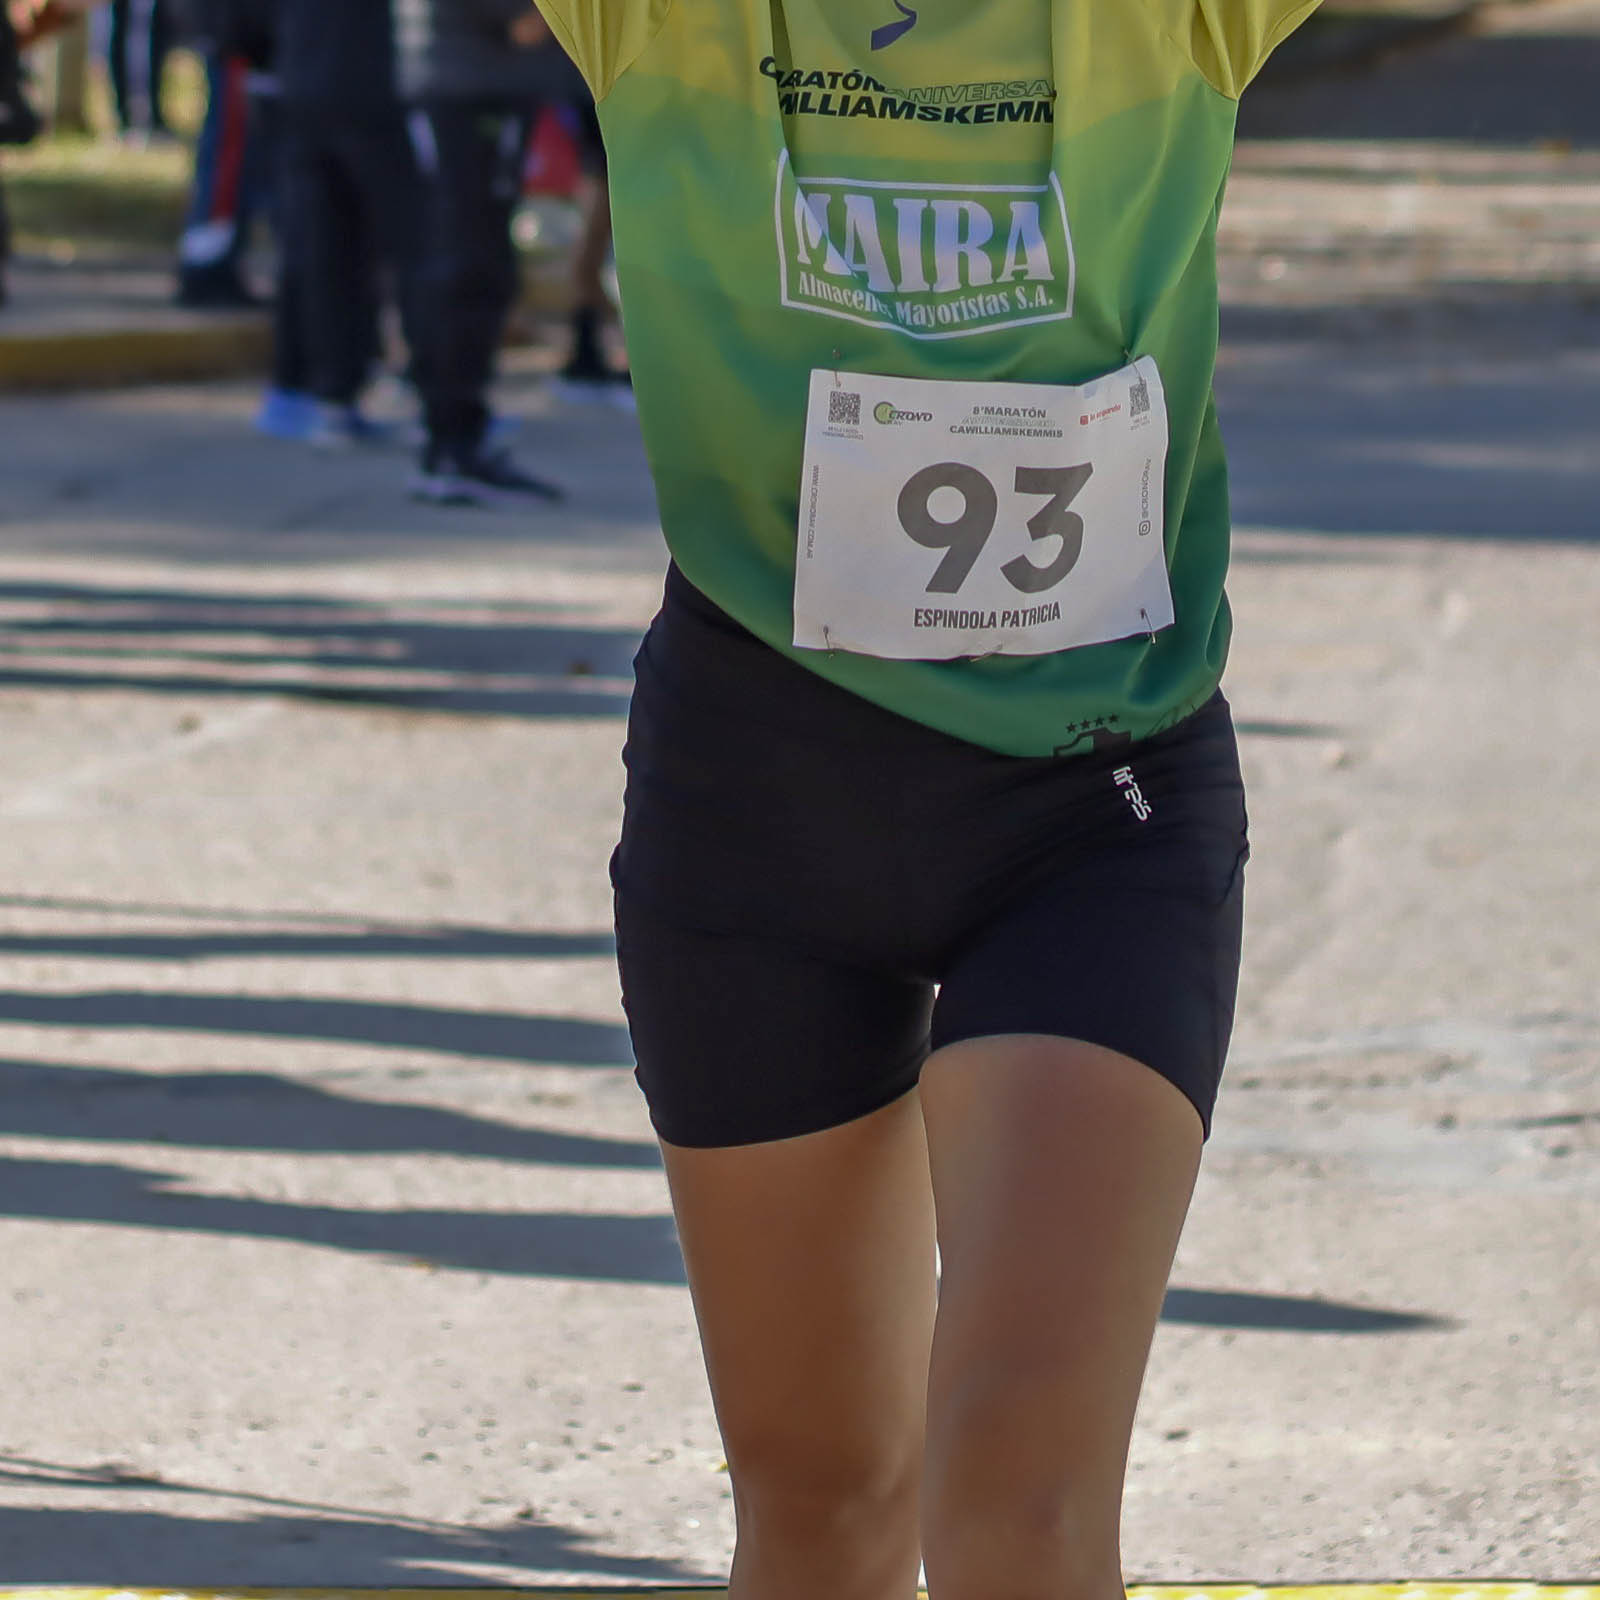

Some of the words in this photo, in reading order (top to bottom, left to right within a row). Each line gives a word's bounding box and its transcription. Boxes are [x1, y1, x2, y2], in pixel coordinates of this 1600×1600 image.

[793, 186, 1055, 293] MAIRA
[895, 290, 1011, 328] Mayoristas
[1015, 284, 1054, 311] S.A.
[896, 461, 1094, 594] 93
[913, 607, 998, 630] ESPINDOLA
[1000, 601, 1061, 629] PATRICIA
